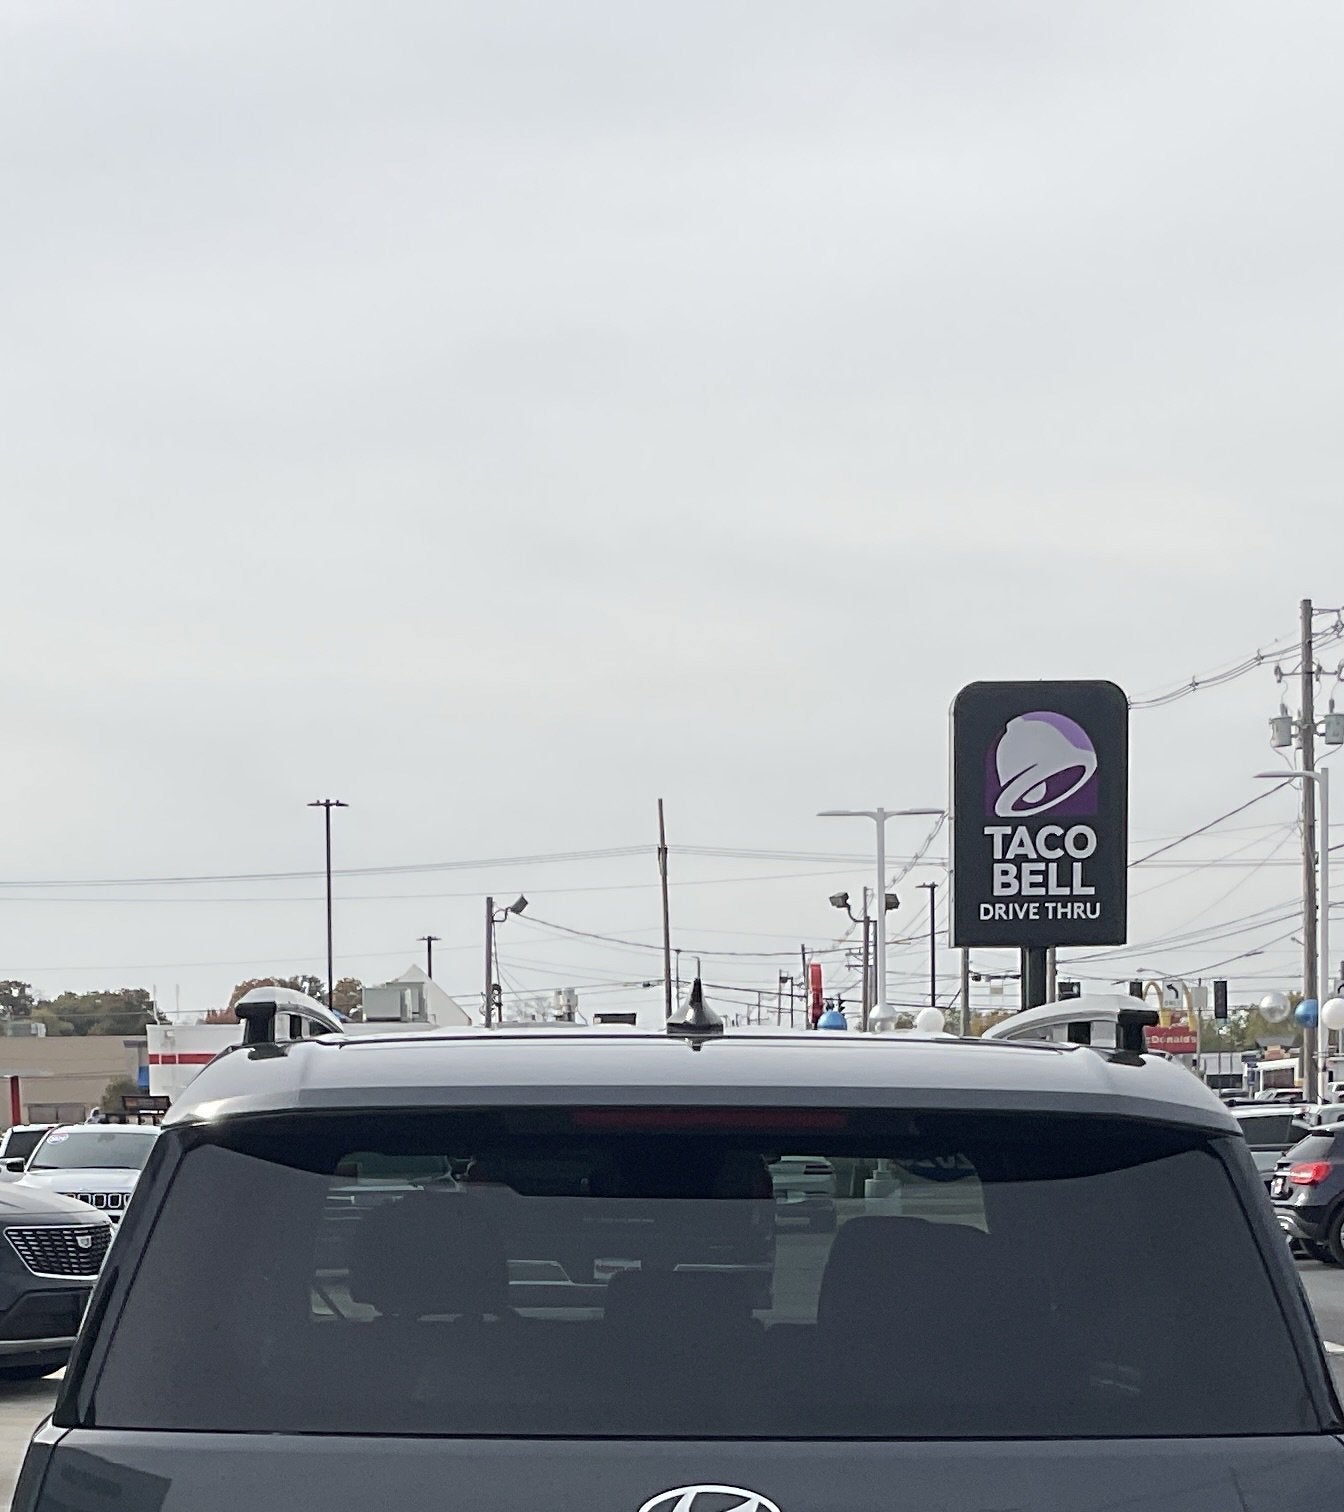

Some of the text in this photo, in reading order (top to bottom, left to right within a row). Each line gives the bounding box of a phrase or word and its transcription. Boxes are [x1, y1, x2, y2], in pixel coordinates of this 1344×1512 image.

[983, 824, 1098, 860] TACO
[992, 861, 1096, 897] BELL
[979, 901, 1101, 921] DRIVE THRU
[1145, 1034, 1198, 1045] cDonald's
